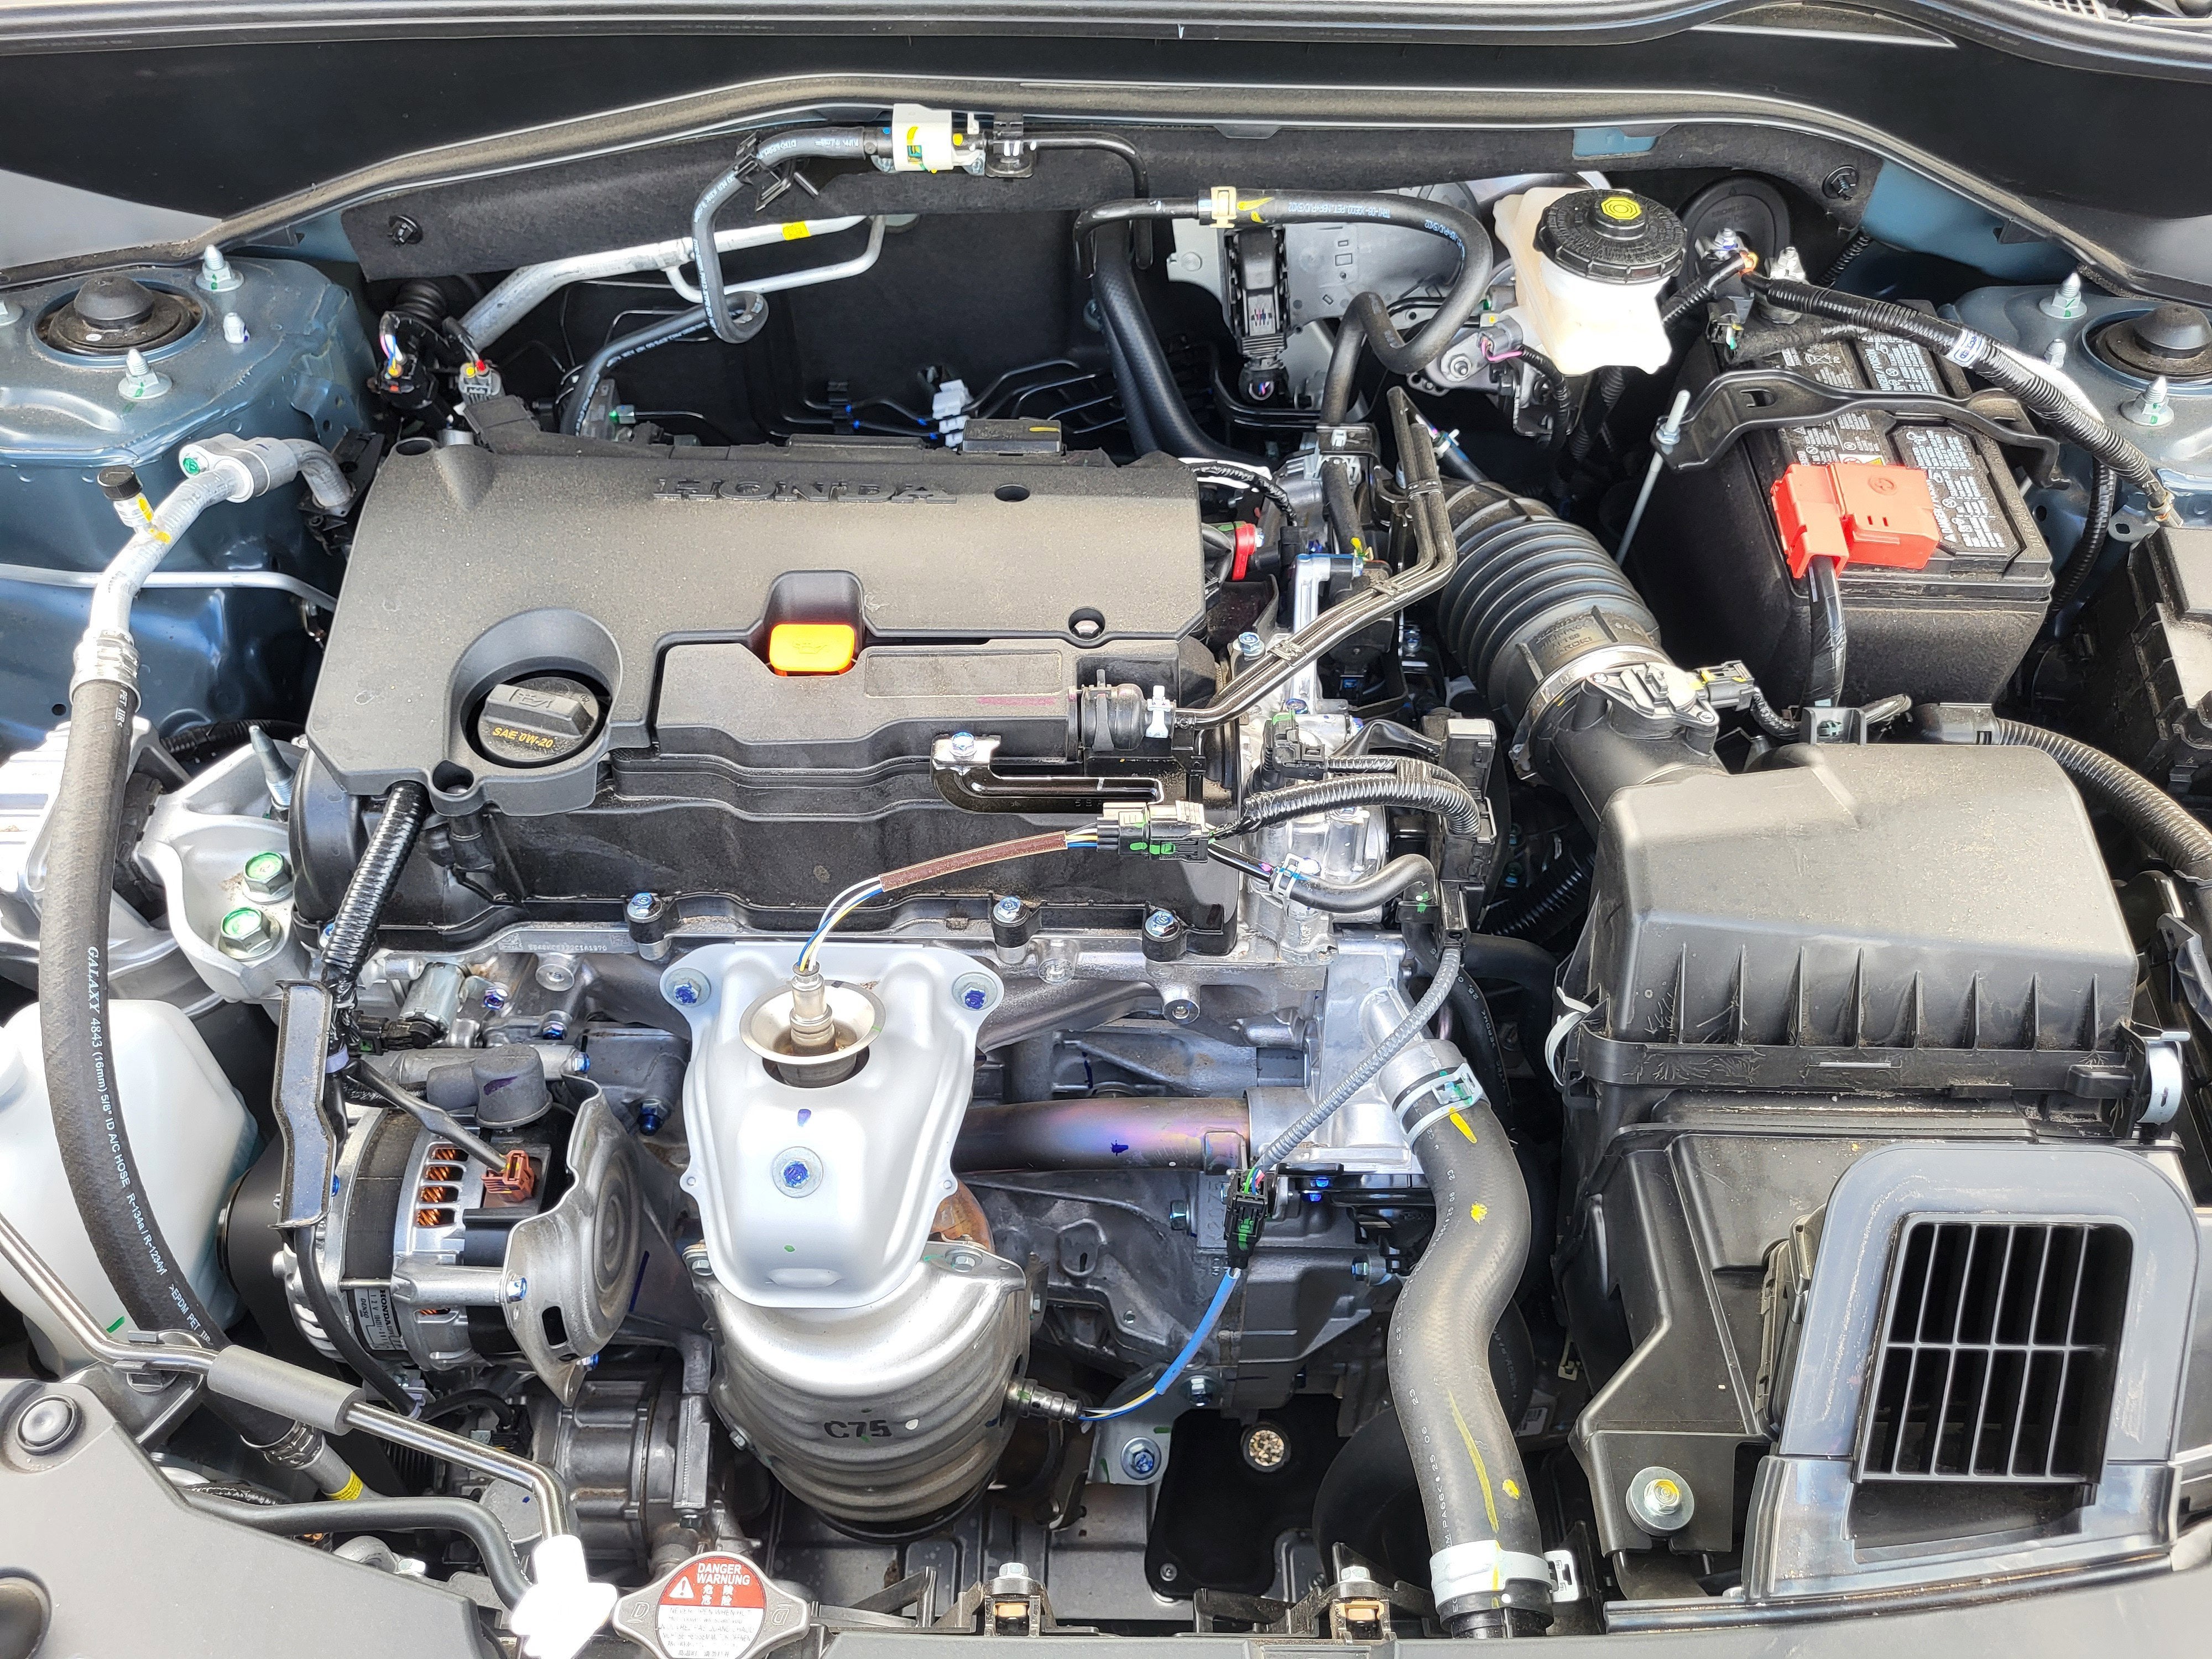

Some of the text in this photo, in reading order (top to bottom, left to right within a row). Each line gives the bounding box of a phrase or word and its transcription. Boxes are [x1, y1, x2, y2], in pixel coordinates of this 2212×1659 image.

[653, 478, 957, 504] HONDA
[492, 727, 554, 749] SAE 0W-20
[87, 946, 100, 1014] GALAXY
[90, 1017, 103, 1048] 4843
[92, 1051, 108, 1092] (16mm)
[105, 1117, 115, 1131] ID
[108, 1133, 121, 1154] A/C
[114, 1154, 132, 1188] HOSE
[1447, 1168, 1456, 1181] 23
[126, 1192, 145, 1231] R-134a
[143, 1234, 168, 1276] R-1234yf
[360, 1298, 369, 1318] DENSO
[379, 1289, 392, 1326] HONDA
[186, 1312, 202, 1332] PET
[1408, 1388, 1420, 1406] 23
[824, 1420, 893, 1439] C75
[1421, 1425, 1430, 1444] 06
[1429, 1453, 1439, 1472] 25
[697, 1562, 742, 1575] DANGER
[696, 1573, 751, 1586] WARNUNG
